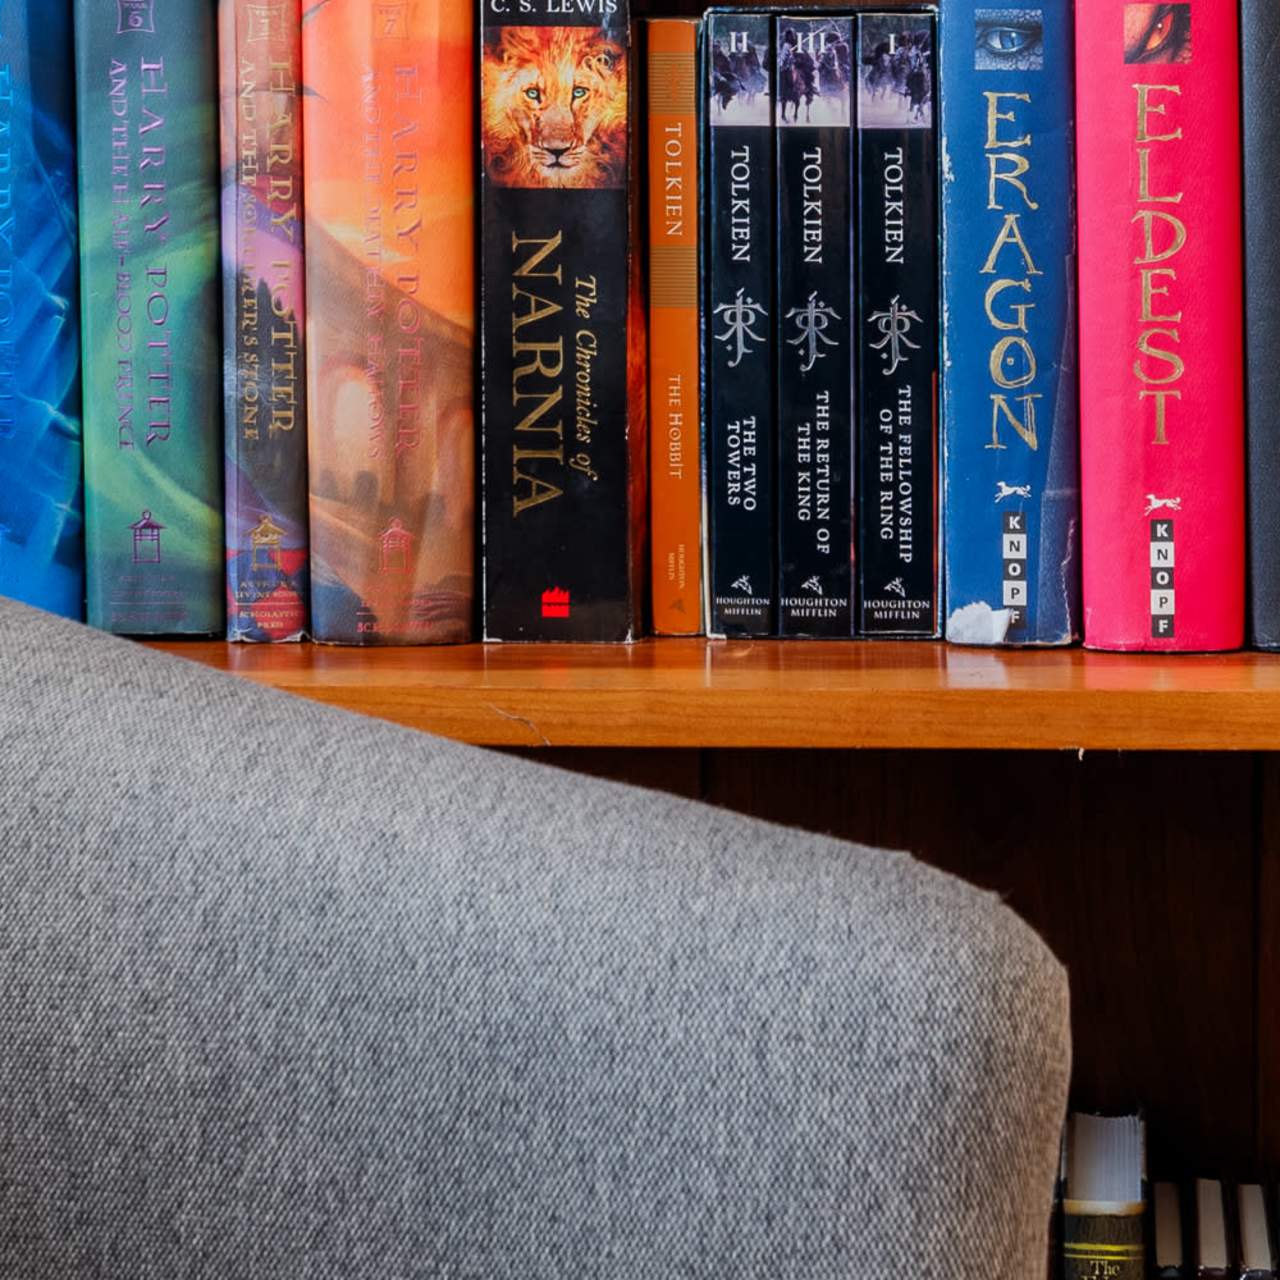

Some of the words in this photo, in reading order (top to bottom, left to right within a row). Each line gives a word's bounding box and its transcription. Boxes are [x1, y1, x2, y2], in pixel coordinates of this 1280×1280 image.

[128, 11, 143, 27] 6
[730, 32, 749, 53] II
[796, 32, 827, 53] III
[889, 33, 897, 55] I
[108, 59, 129, 118] AND
[238, 60, 258, 119] AND
[111, 121, 131, 177] THE
[138, 56, 169, 240] HARRY
[240, 132, 260, 187] THE
[267, 59, 297, 241] HARRY
[391, 63, 423, 252] HARRY
[665, 122, 683, 236] TOLKIEN
[731, 145, 751, 263] TOLKIEN
[803, 147, 823, 264] TOLKIEN
[884, 147, 904, 264] TOLKIEN
[112, 182, 133, 353] HALF-BLOOD
[979, 91, 1044, 451] ERAGON
[1130, 83, 1188, 445] ELDEST
[575, 275, 597, 319] The
[145, 265, 172, 448] POTTER
[270, 260, 298, 438] POTTER
[394, 273, 423, 458] POTTER
[512, 229, 564, 519] NARNIA
[115, 358, 134, 450] PRINCE
[238, 353, 259, 441] STONE
[575, 329, 598, 444] Chronicles
[668, 375, 682, 407] THE
[816, 391, 830, 432] THE
[898, 385, 912, 426] THE
[669, 413, 682, 480] HOBBIT
[743, 416, 757, 457] THE
[798, 423, 811, 464] THE
[880, 409, 894, 435] OF
[569, 453, 598, 481] of
[727, 421, 741, 506] TOWERS
[743, 463, 757, 511] TWO
[816, 438, 830, 521] RETURN
[880, 442, 894, 483] THE
[798, 471, 811, 522] KING
[880, 491, 894, 541] RING
[898, 434, 913, 564] FELLOWSHIP
[816, 528, 830, 555] OF
[1007, 515, 1023, 624] KNOPF
[716, 597, 770, 606] HOUGHTON
[780, 597, 848, 607] HOUGHTON
[863, 599, 931, 609] HOUGHTON
[1154, 521, 1171, 635] KNOPF
[724, 608, 762, 616] MIFFLIN
[790, 608, 838, 618] MIFFLIN
[873, 611, 921, 620] MIFFLIN
[1090, 1260, 1120, 1276] The
